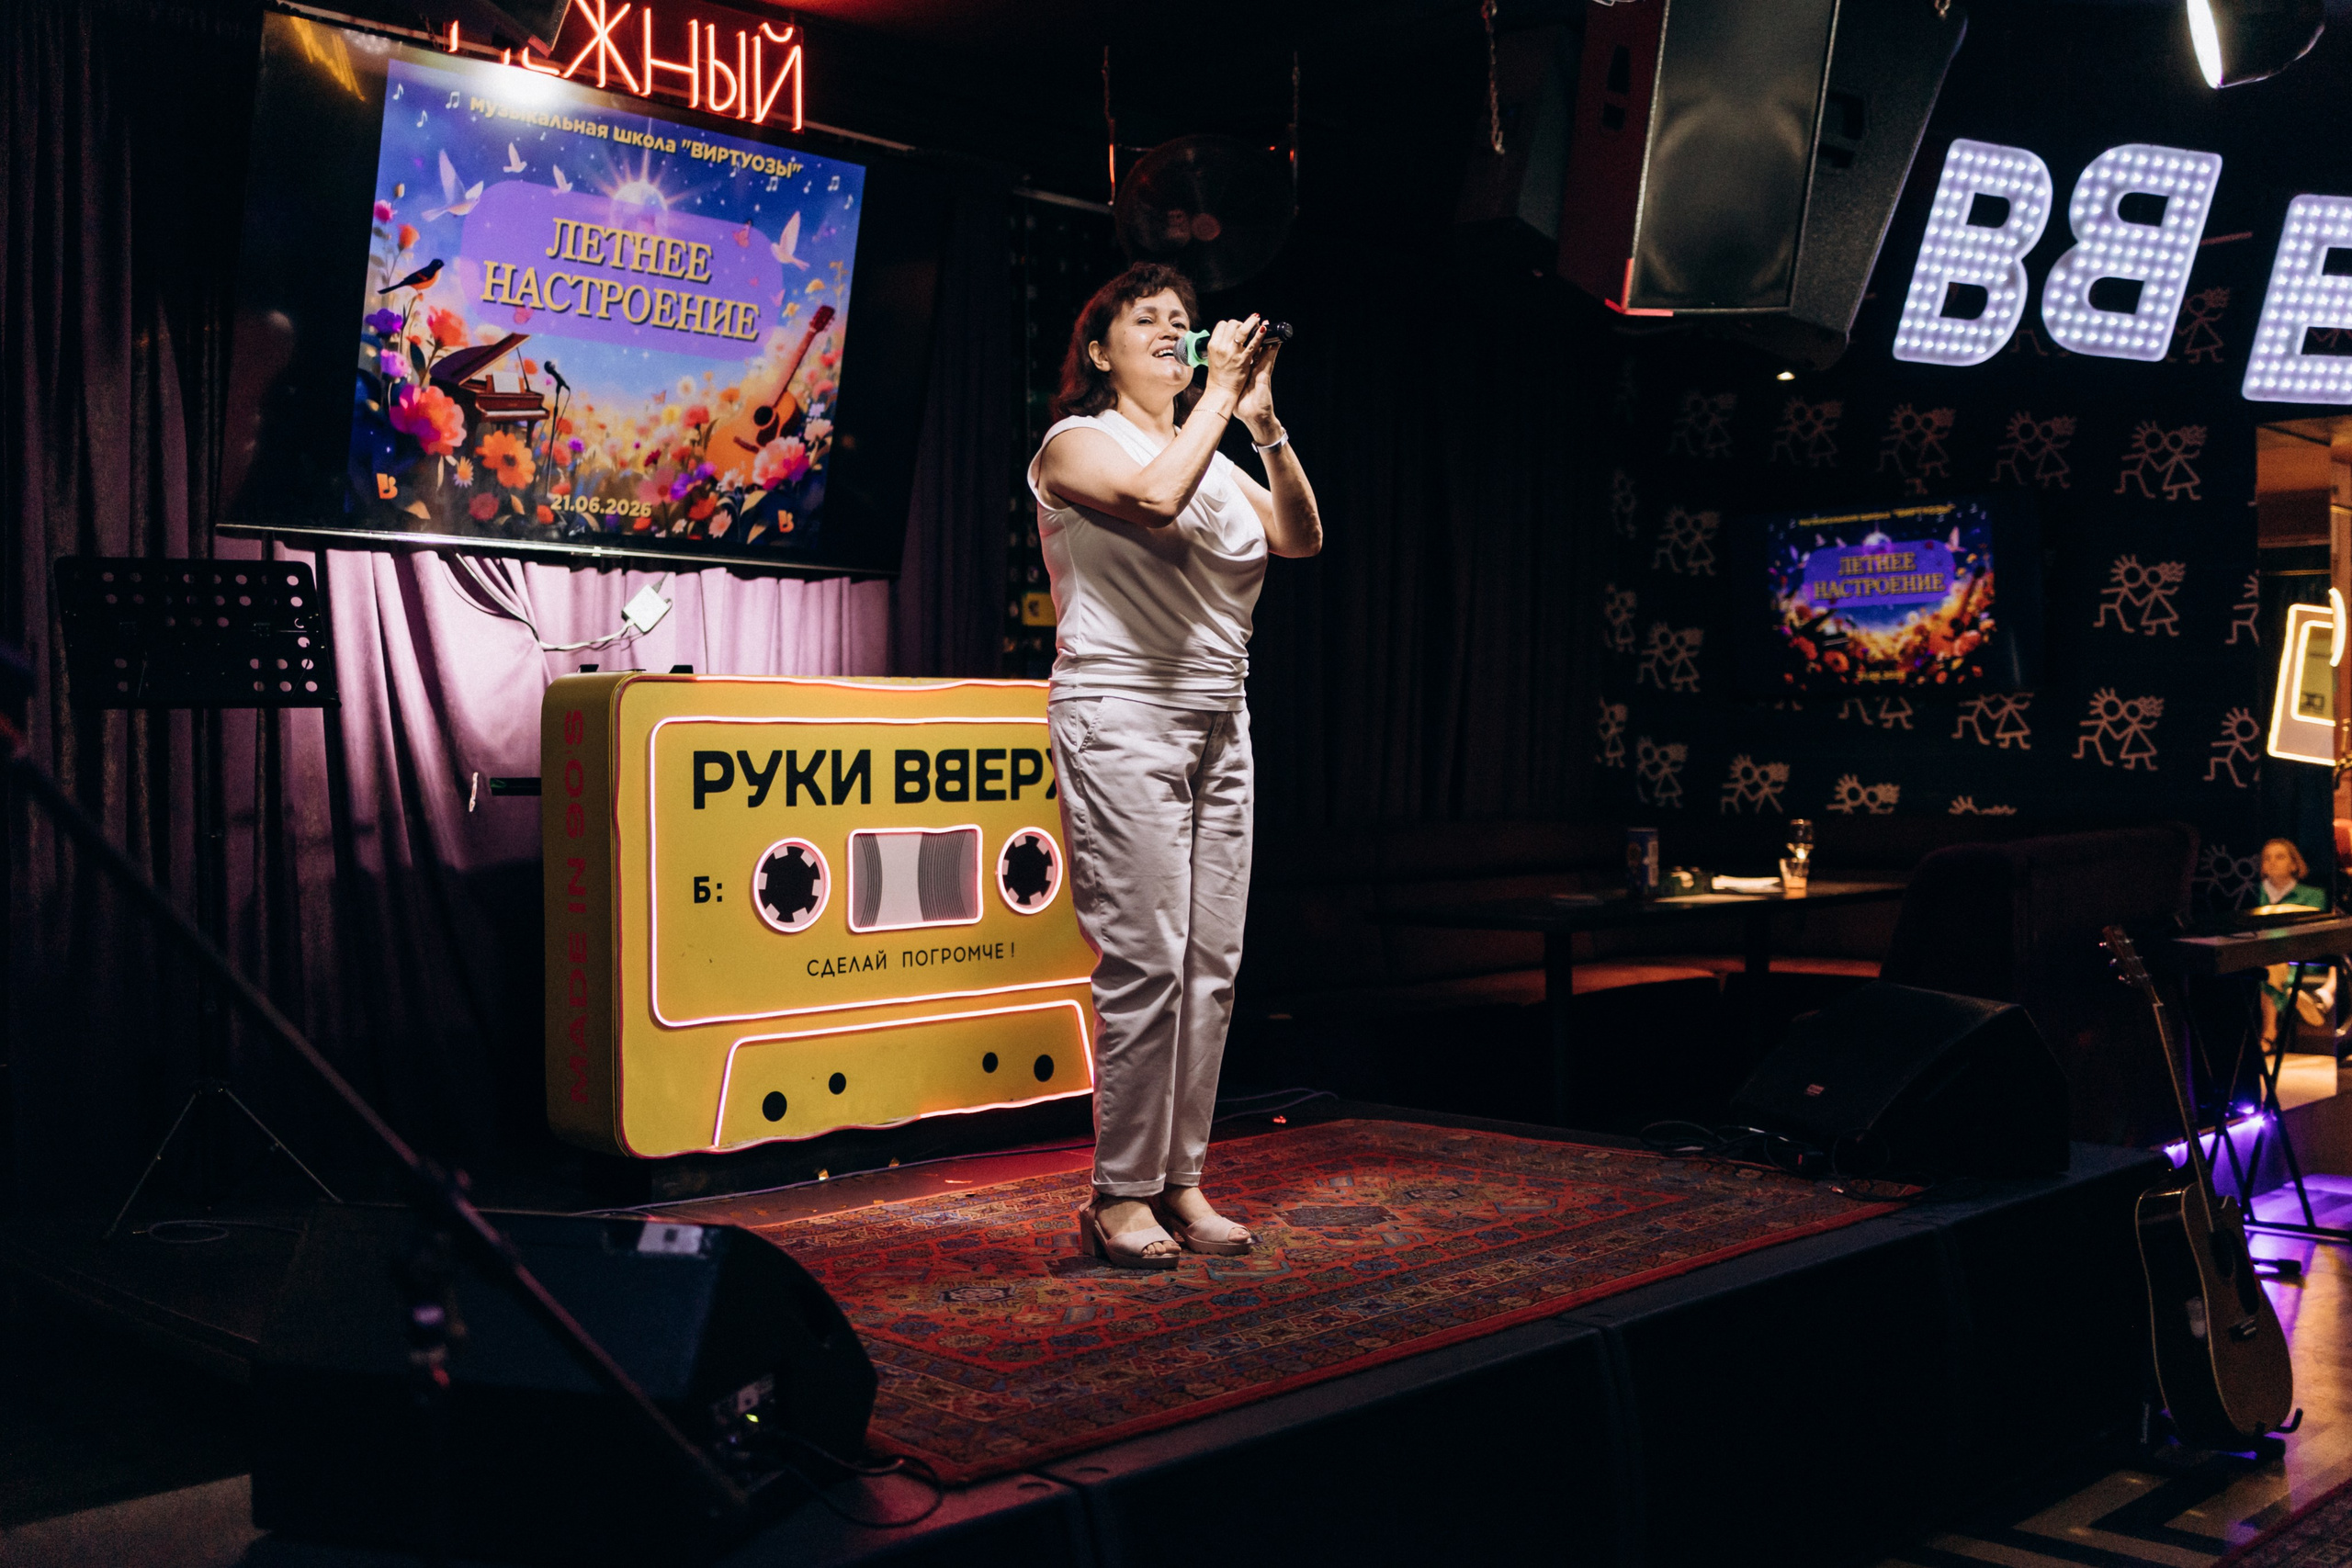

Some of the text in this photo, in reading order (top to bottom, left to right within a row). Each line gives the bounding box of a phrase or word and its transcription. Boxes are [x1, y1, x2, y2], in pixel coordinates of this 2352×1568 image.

[613, 125, 676, 154] школа
[681, 139, 804, 180] "ВИРТУОЗЫ"
[546, 217, 712, 283] ЛЕТНЕЕ
[480, 260, 761, 341] НАСТРОЕНИЕ
[550, 492, 652, 518] 21.06.2026
[1813, 573, 1947, 600] НАСТРОЕНИЕ
[1838, 552, 1917, 576] ЛЕТНЕЕ
[694, 749, 871, 809] РУКИ
[567, 856, 587, 914] IN
[694, 875, 723, 904] Б:
[807, 949, 888, 978] СДЕЛАЙ
[568, 931, 589, 1103] MADE
